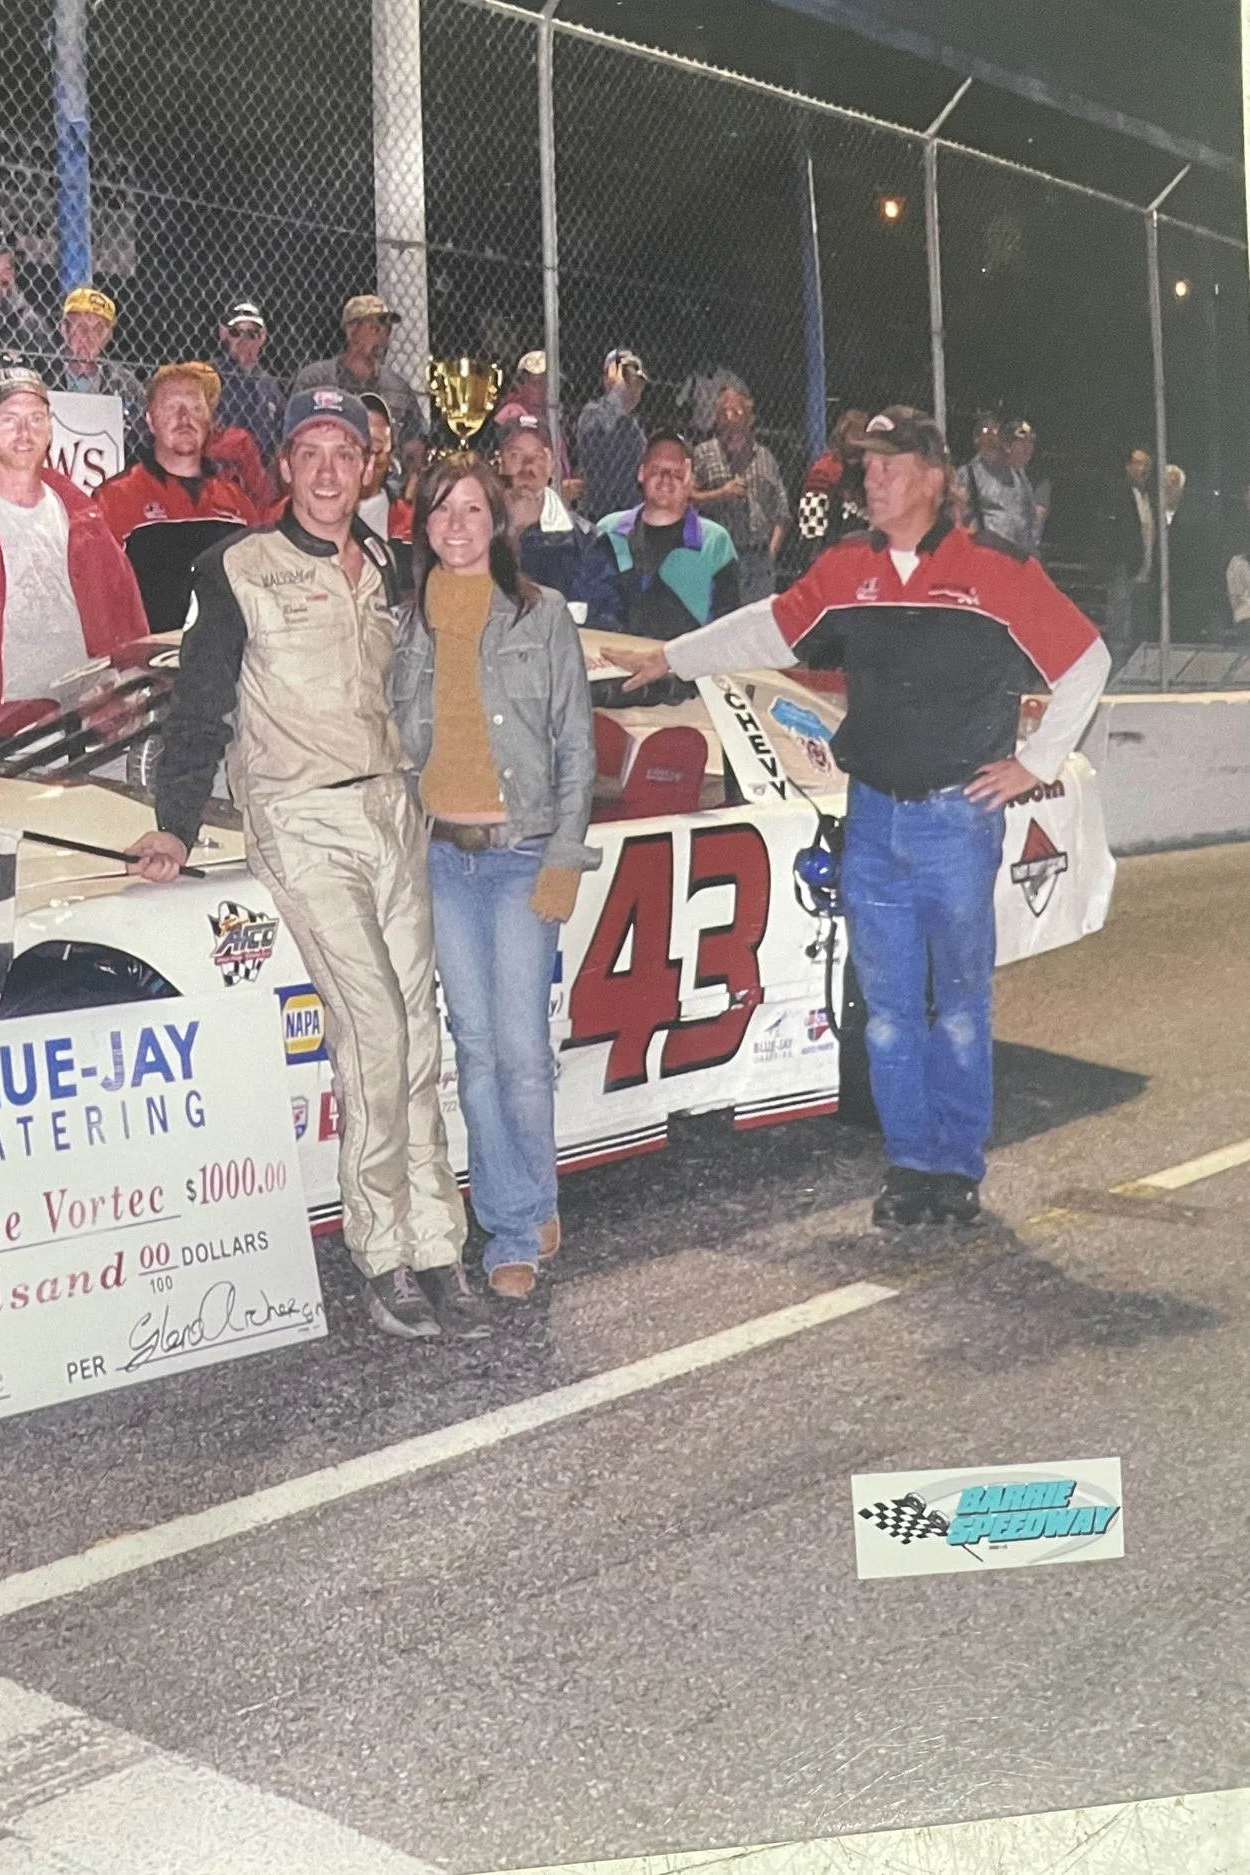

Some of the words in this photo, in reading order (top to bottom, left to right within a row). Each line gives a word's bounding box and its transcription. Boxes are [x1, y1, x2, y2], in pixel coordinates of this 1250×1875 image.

[561, 823, 770, 1094] 43
[286, 1009, 321, 1039] NAPA
[42, 1184, 164, 1234] Vortec
[186, 1157, 287, 1205] $1000.00
[139, 1242, 171, 1269] 00
[182, 1231, 269, 1266] DOLLARS
[150, 1275, 173, 1294] 100
[67, 1355, 107, 1383] PER
